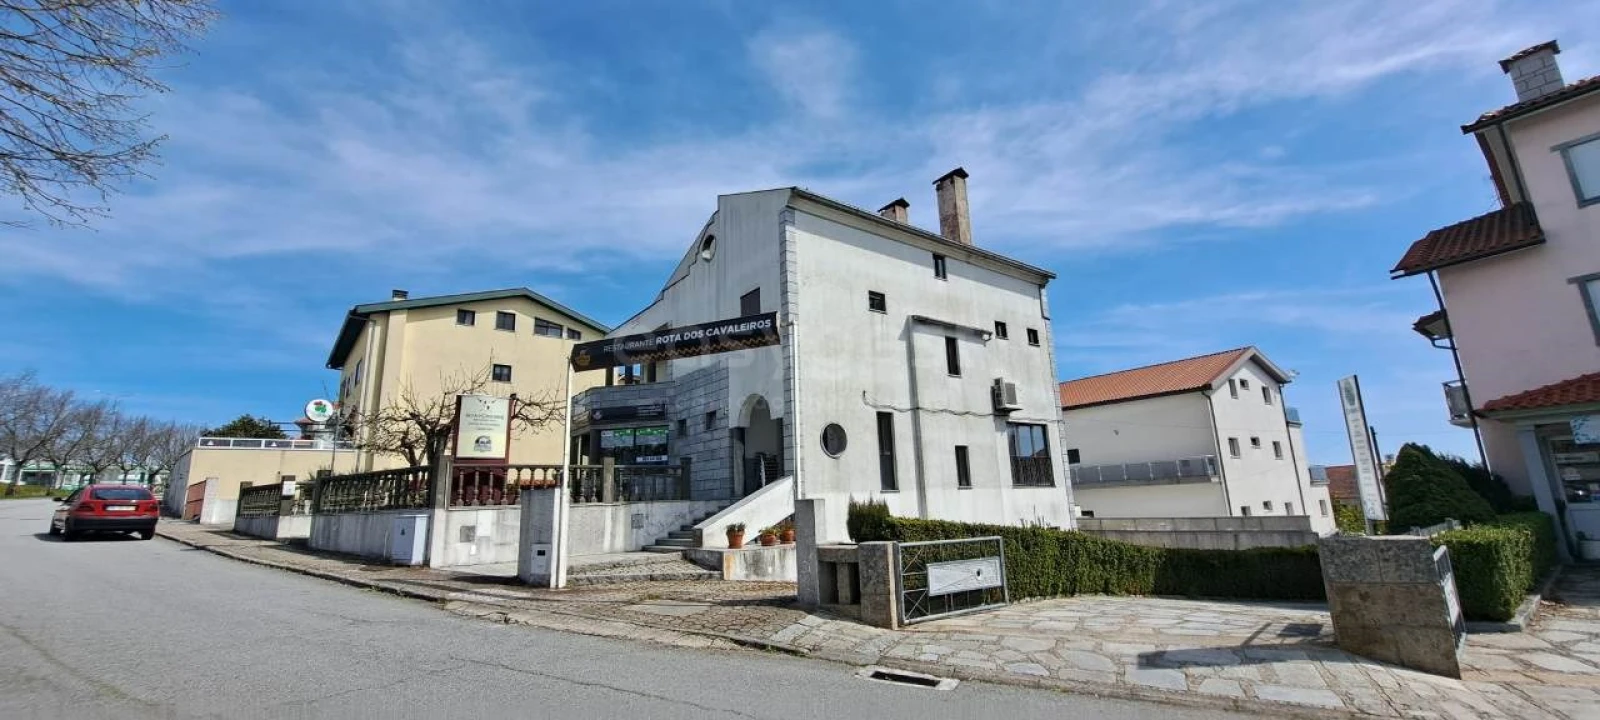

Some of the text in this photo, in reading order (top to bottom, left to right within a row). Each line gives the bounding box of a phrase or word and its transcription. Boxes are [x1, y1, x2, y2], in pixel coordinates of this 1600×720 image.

[604, 319, 772, 352] RESTAURANTE ROTA DOS CAVALEIROS
